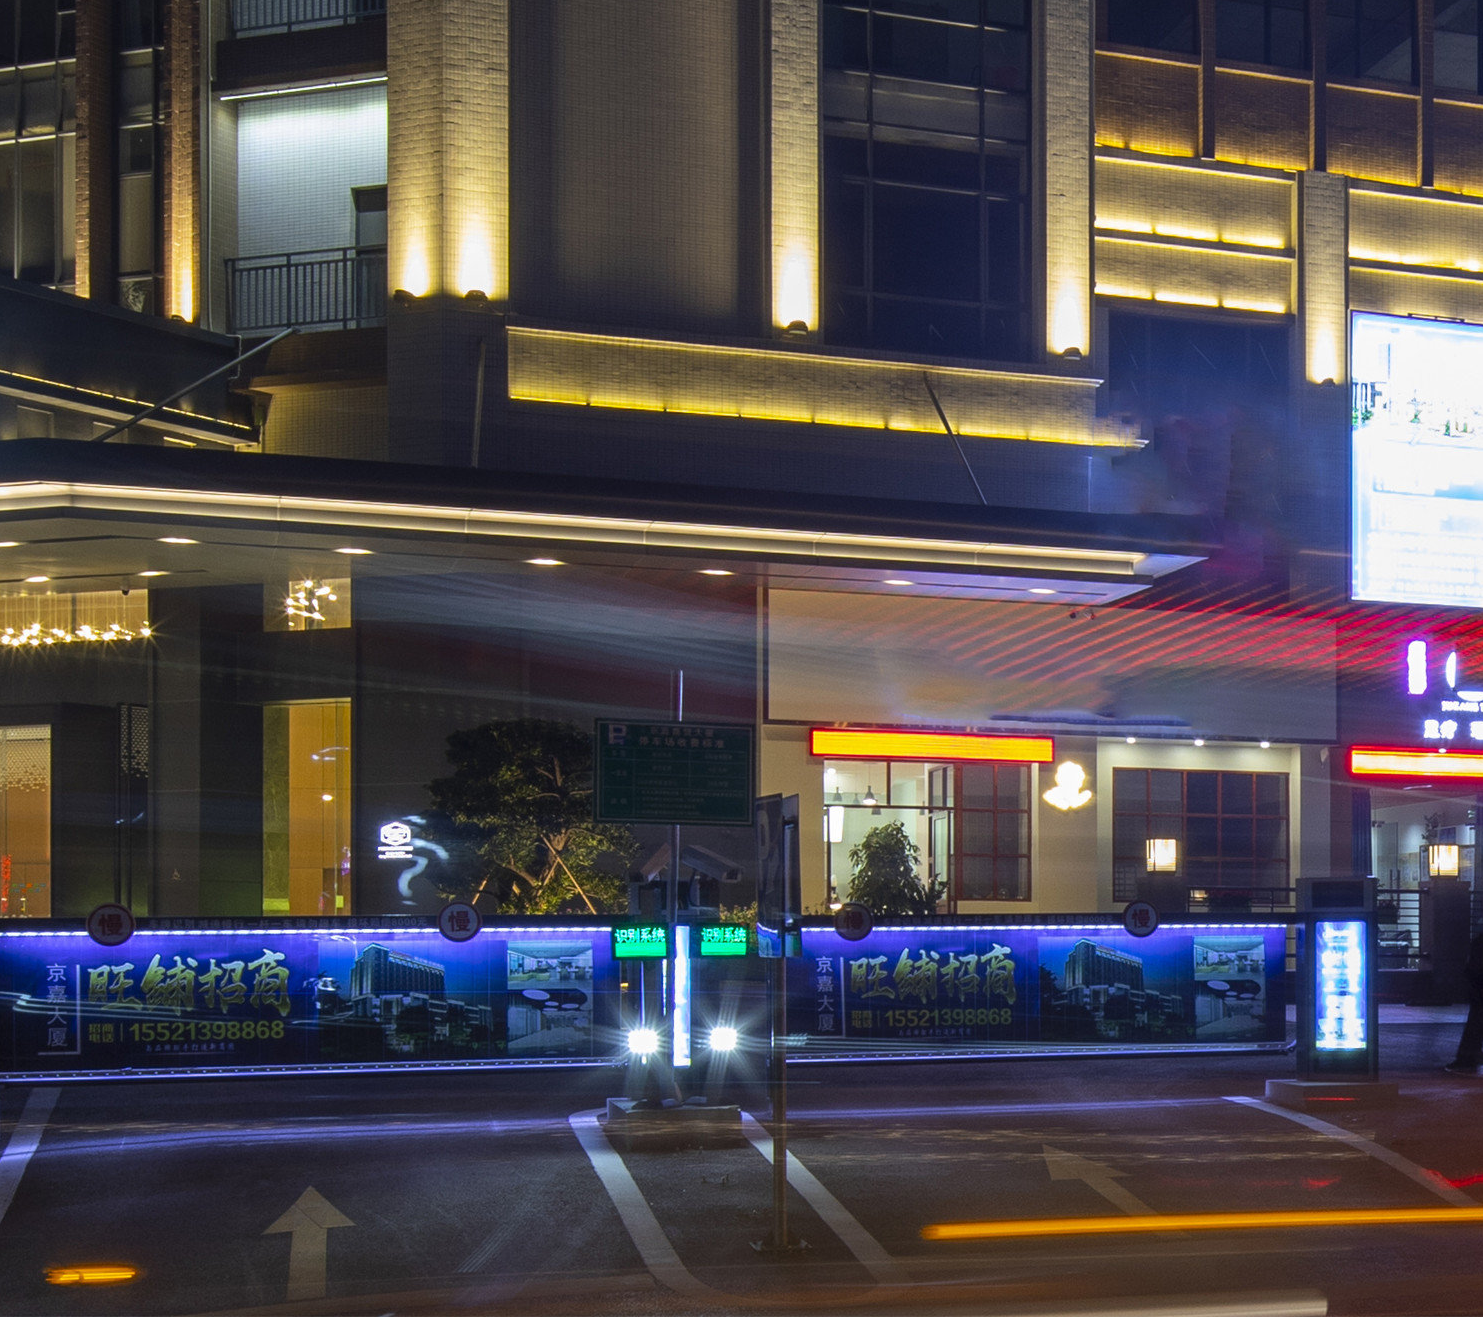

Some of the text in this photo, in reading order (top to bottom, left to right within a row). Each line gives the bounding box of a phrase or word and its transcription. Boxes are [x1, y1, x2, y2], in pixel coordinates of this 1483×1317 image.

[98, 913, 124, 936] 慢
[448, 911, 470, 932] 慢
[1132, 908, 1151, 929] 慢
[615, 927, 666, 943] 识别系统
[701, 927, 747, 943] 识别系统
[815, 956, 836, 1032] 京嘉大厦
[46, 963, 68, 1047] 京嘉大厦
[885, 1007, 1012, 1027] 15521398868
[129, 1020, 285, 1042] 15521398868
